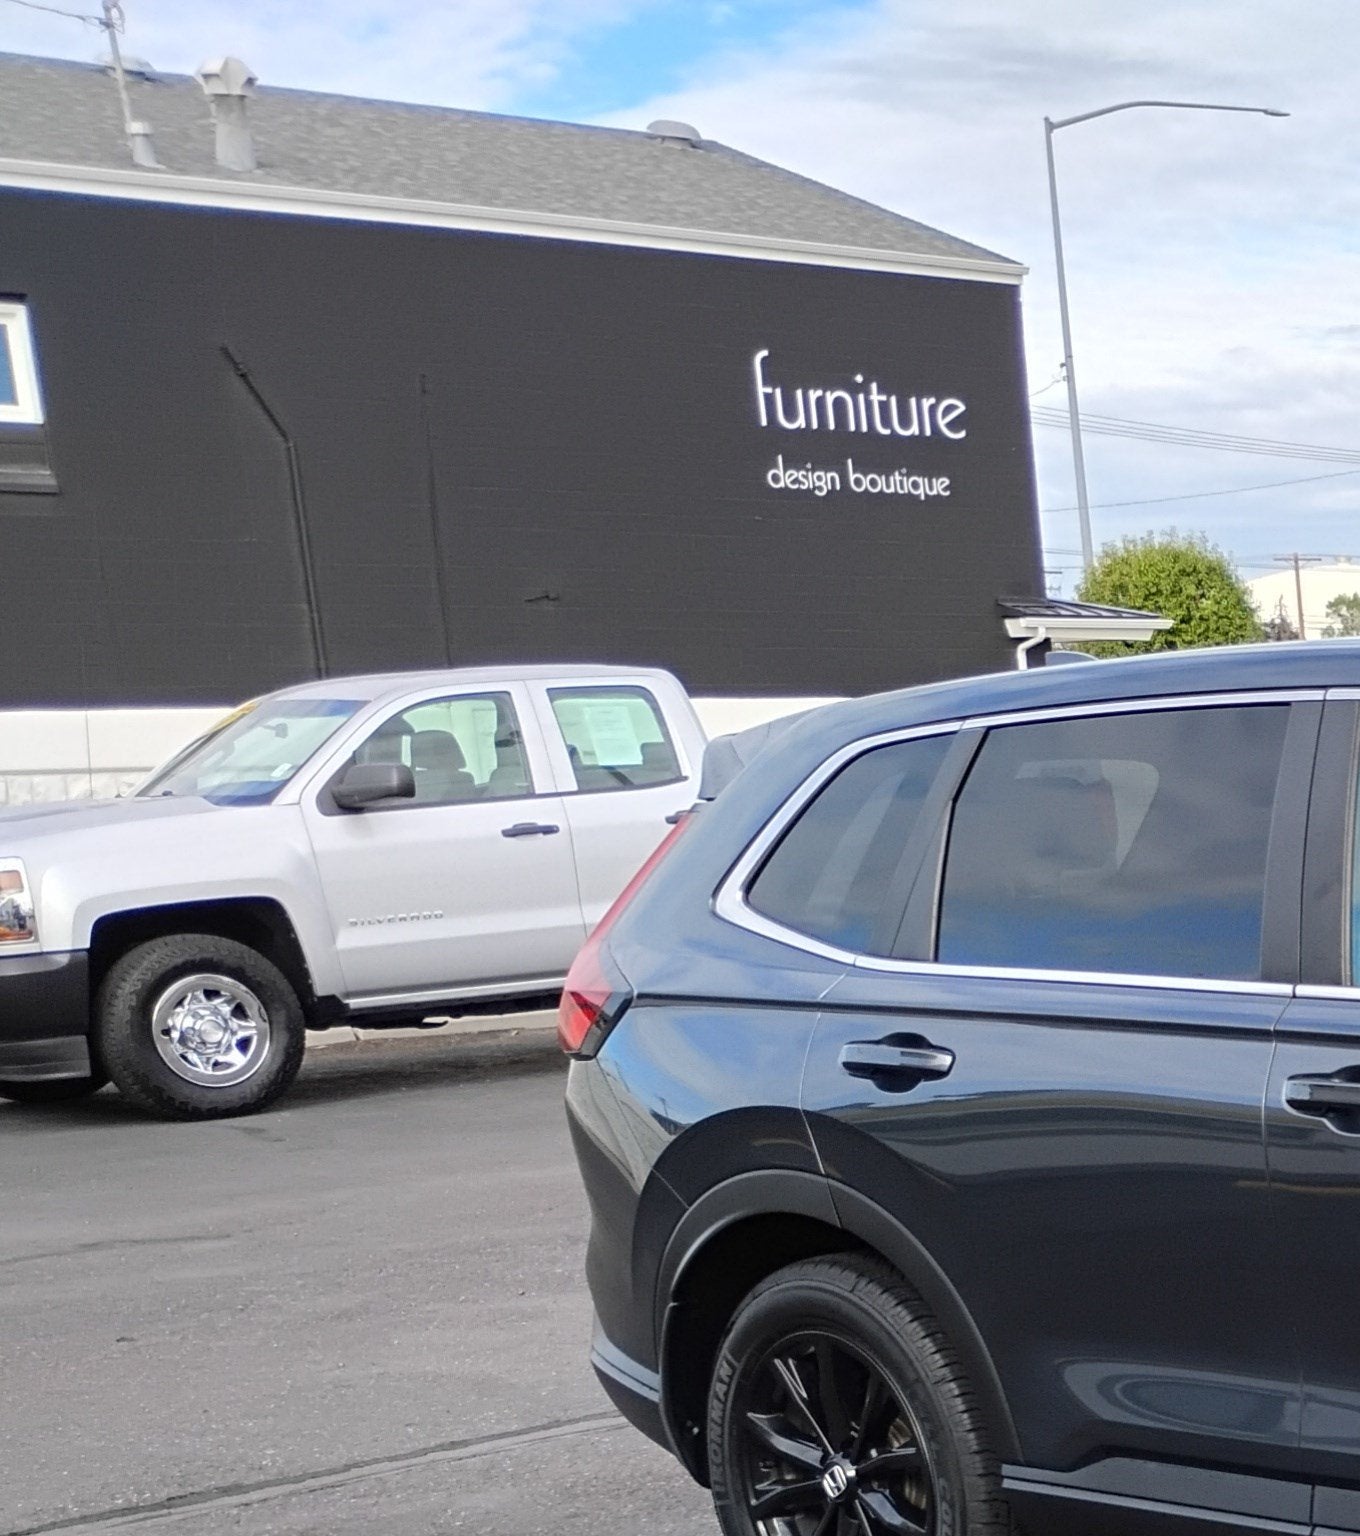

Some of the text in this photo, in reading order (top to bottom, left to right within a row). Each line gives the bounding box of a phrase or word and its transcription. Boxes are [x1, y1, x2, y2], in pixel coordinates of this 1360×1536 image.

[754, 350, 966, 439] furniture
[767, 454, 950, 500] design boutique
[348, 910, 444, 927] SILVERADO
